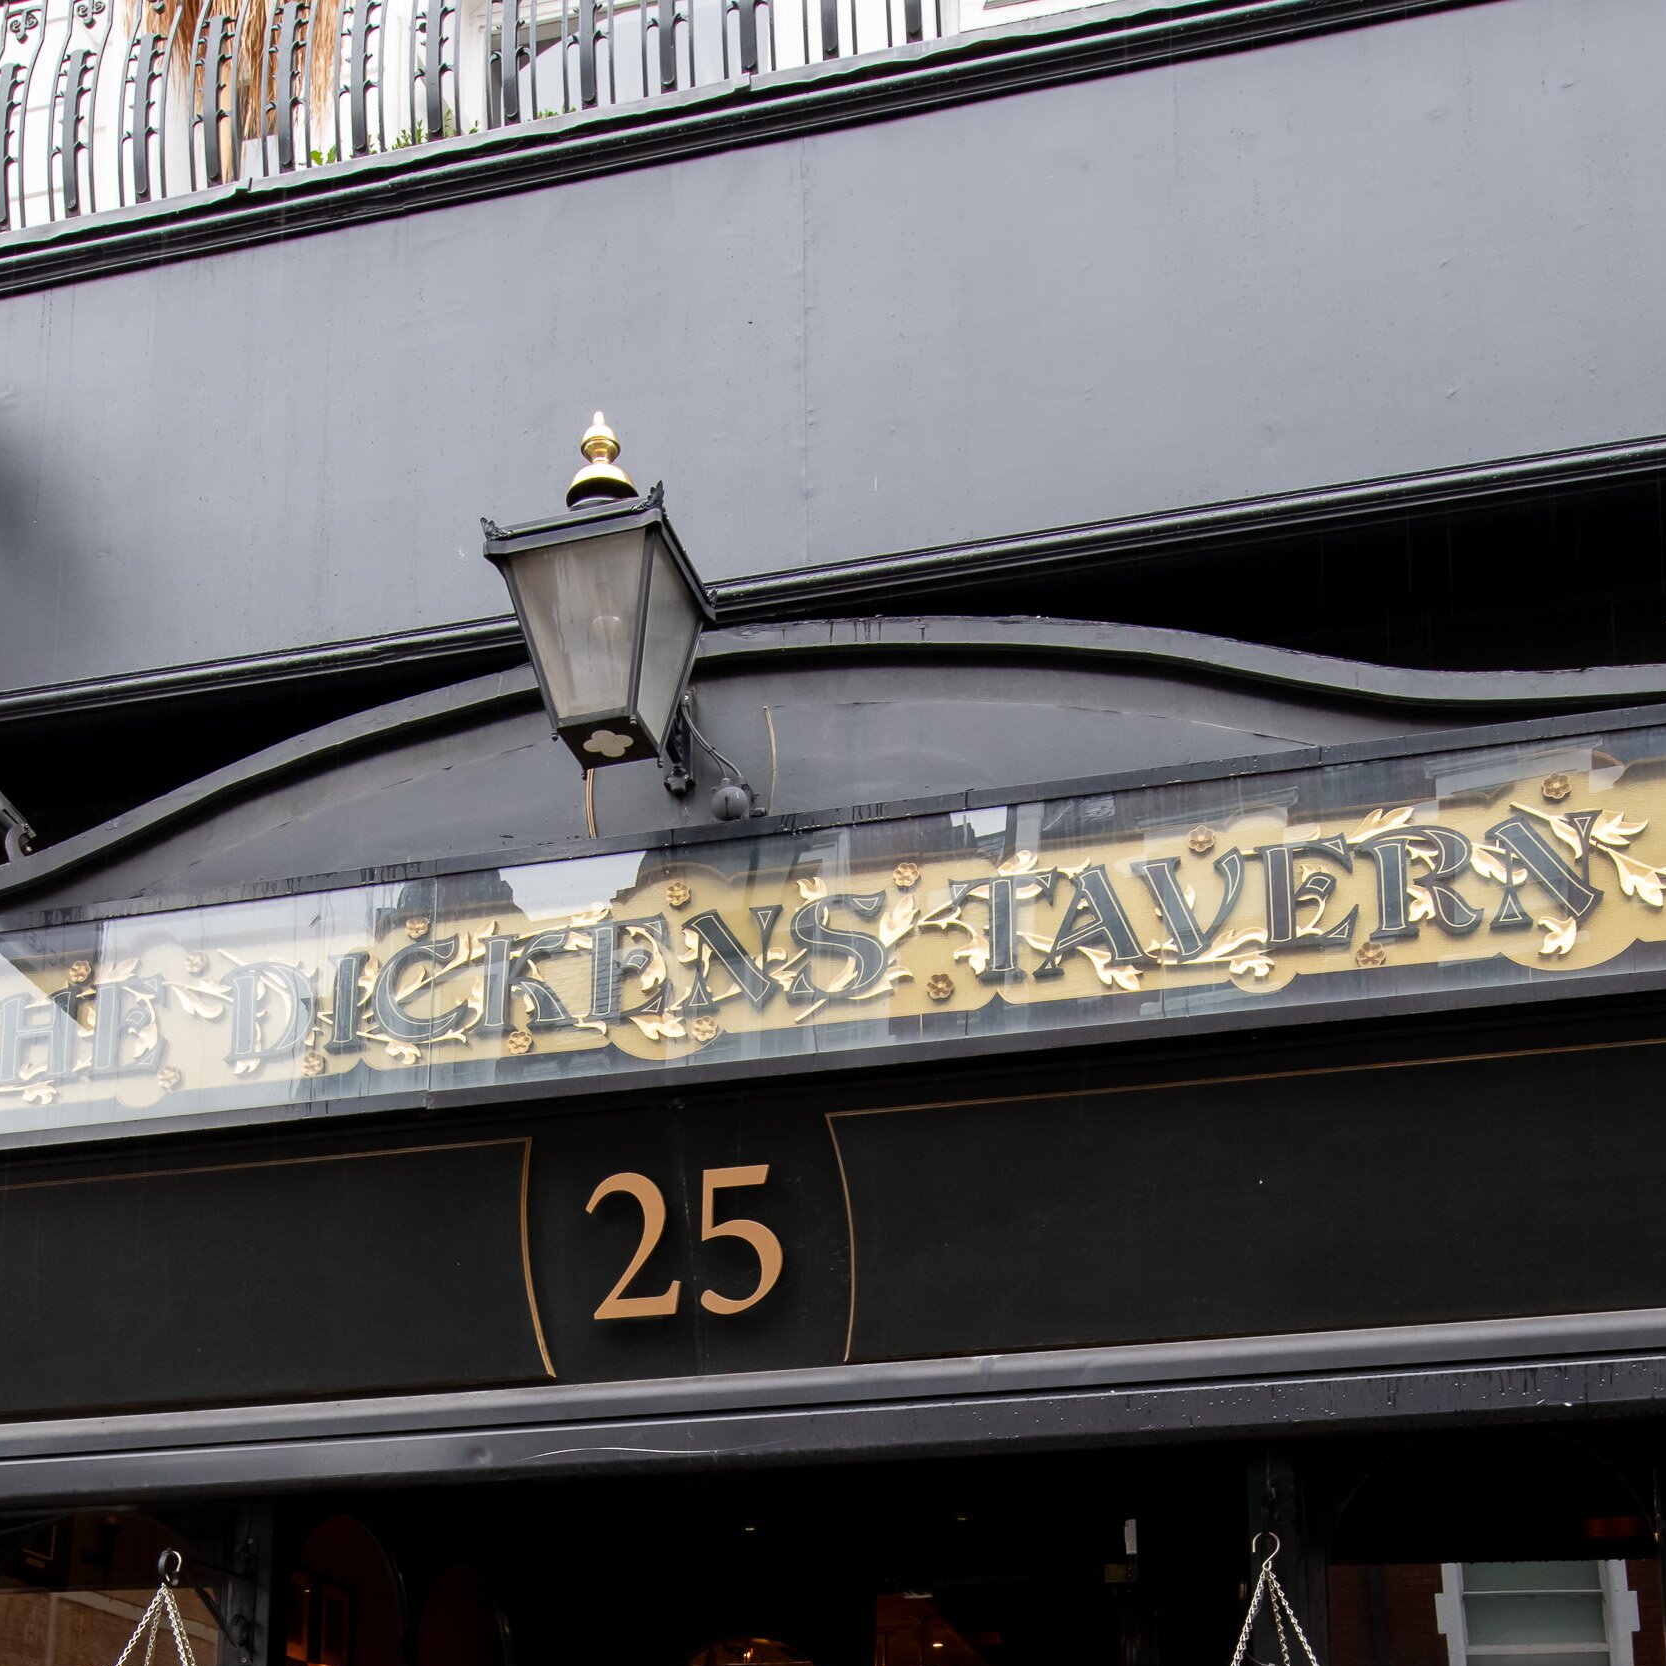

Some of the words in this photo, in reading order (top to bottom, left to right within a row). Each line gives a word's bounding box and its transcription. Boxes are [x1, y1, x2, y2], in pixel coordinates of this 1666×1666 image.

[222, 889, 890, 1065] DICKENS
[947, 807, 1606, 983] TAVERN
[584, 1163, 784, 1321] 25
